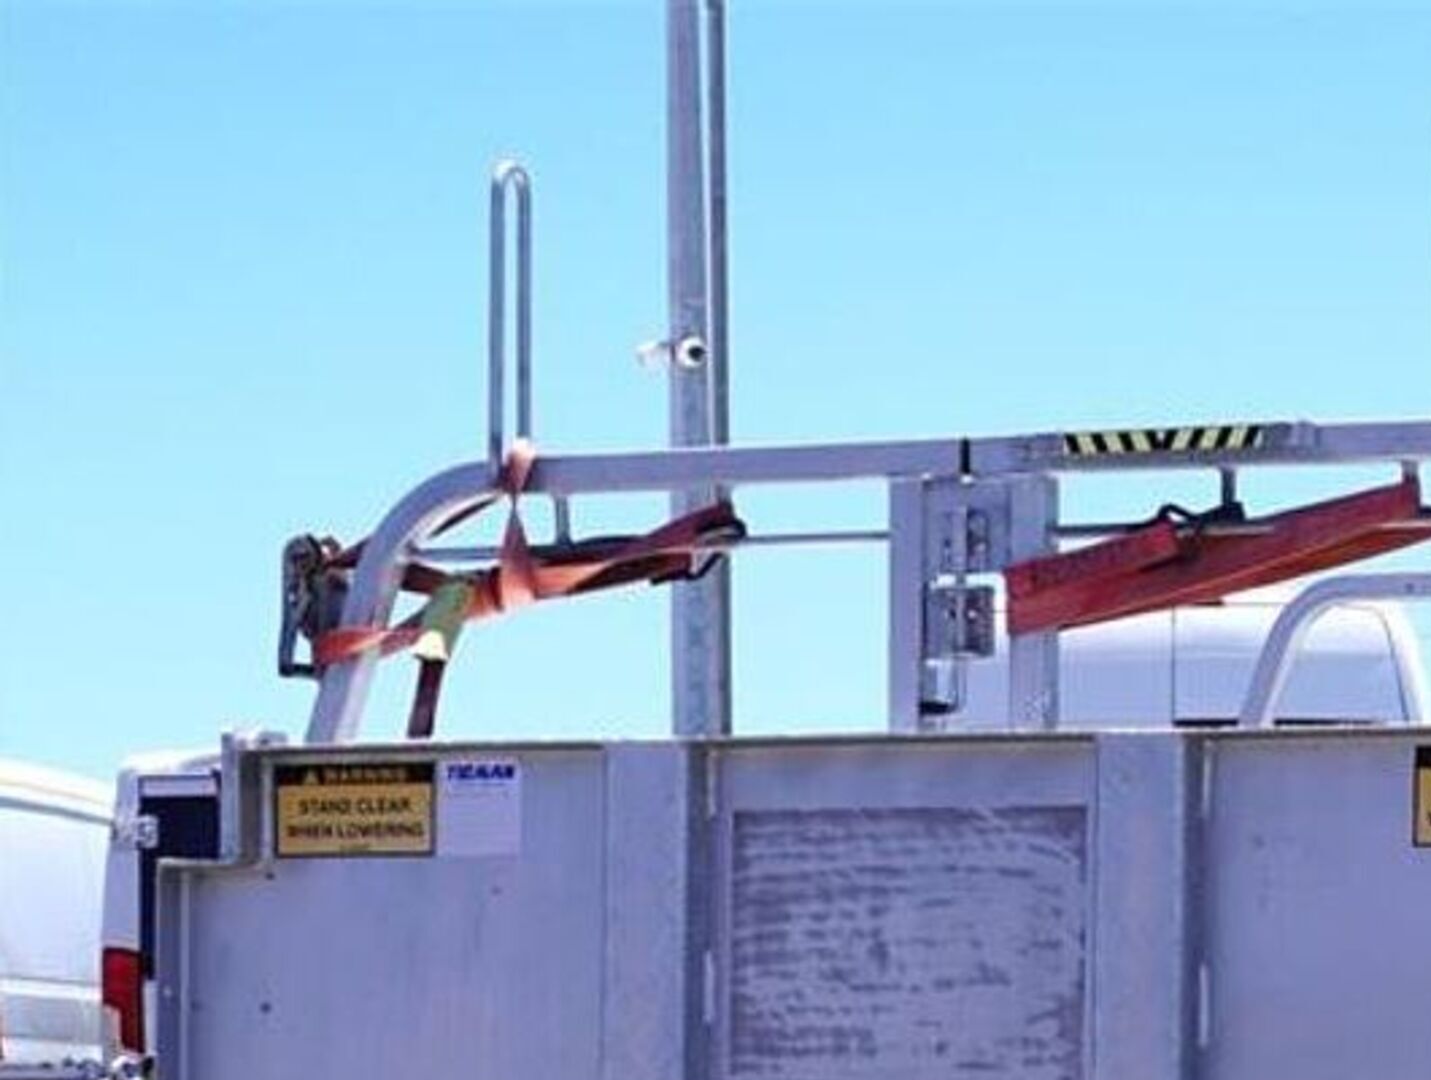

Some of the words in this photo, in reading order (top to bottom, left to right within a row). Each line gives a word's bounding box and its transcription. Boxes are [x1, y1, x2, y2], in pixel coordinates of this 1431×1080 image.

[299, 797, 350, 816] STAND
[355, 797, 413, 814] CLEAR
[286, 822, 334, 839] WHEN
[337, 821, 425, 838] LOWERING
